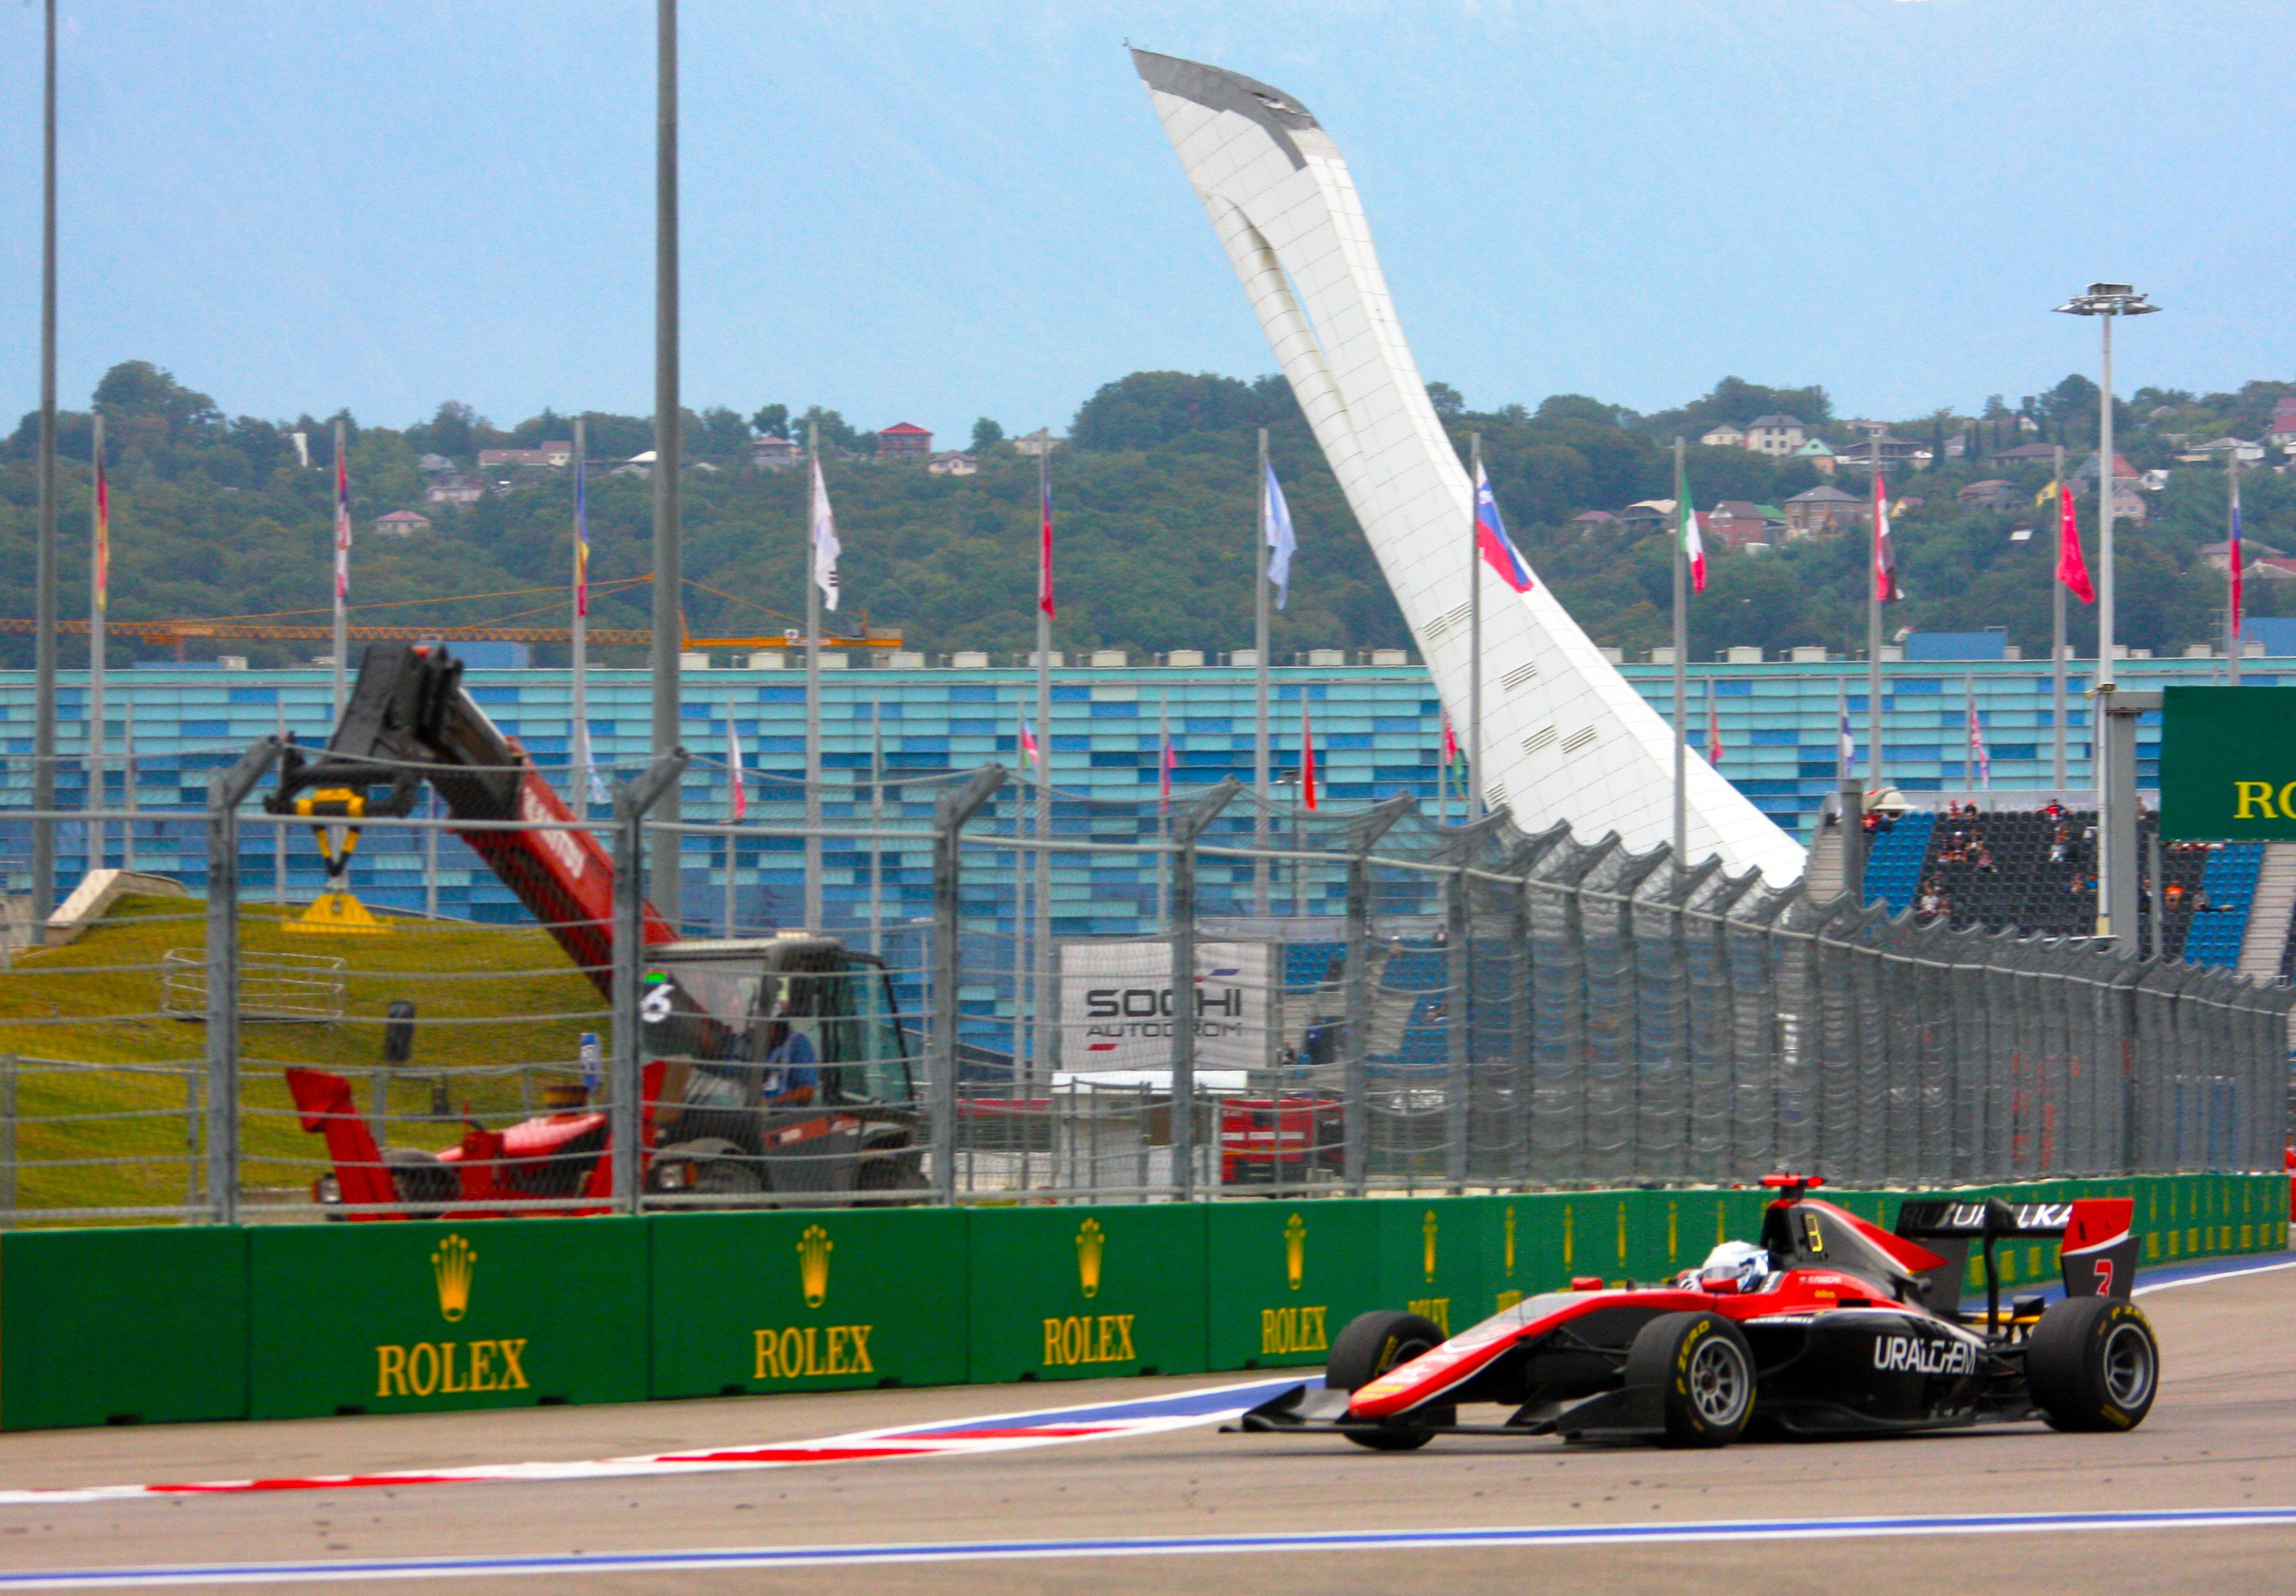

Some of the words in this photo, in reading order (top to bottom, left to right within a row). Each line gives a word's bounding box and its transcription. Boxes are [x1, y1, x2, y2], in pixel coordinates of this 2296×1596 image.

[639, 984, 675, 1023] 6
[752, 1325, 875, 1380] ROLEX
[1042, 1314, 1136, 1366] ROLEX
[1260, 1305, 1328, 1355] ROLEX
[375, 1338, 531, 1397] ROLEX
